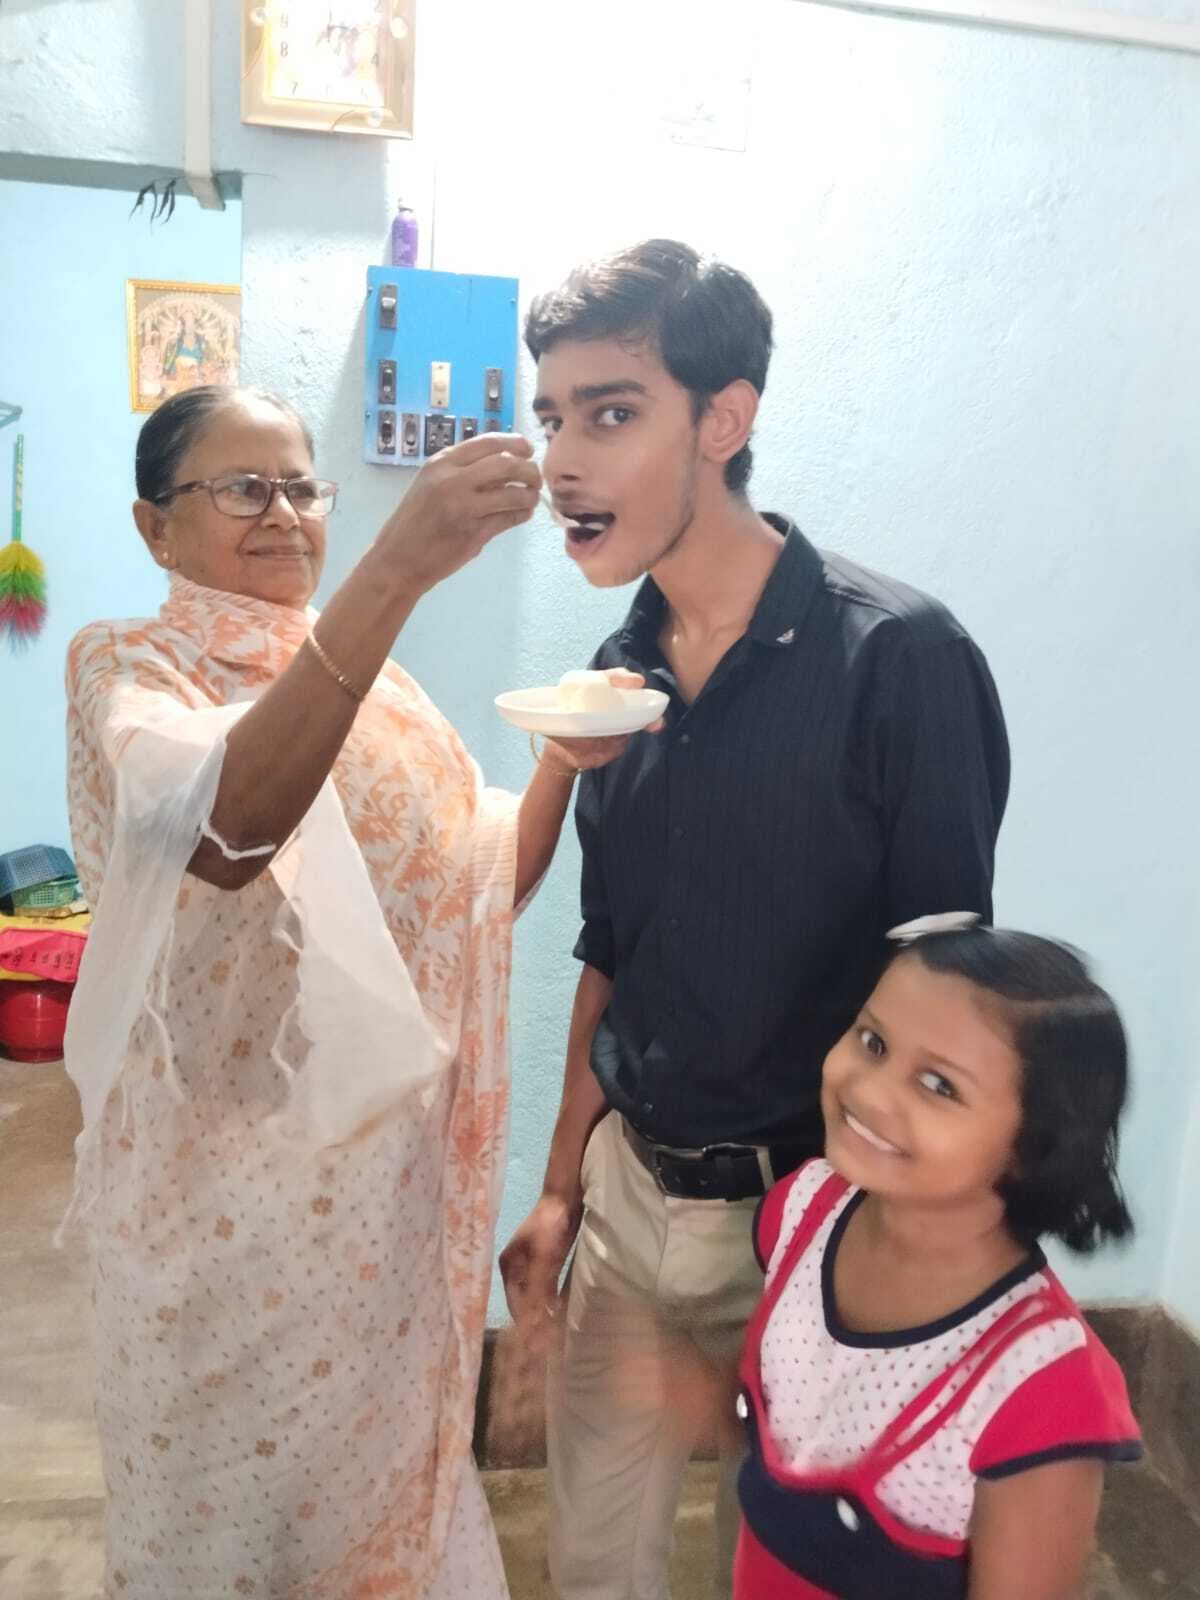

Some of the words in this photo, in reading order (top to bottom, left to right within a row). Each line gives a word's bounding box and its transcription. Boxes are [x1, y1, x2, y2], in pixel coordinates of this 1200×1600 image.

[280, 40, 289, 57] 8
[371, 53, 380, 67] 4
[290, 79, 299, 96] 7
